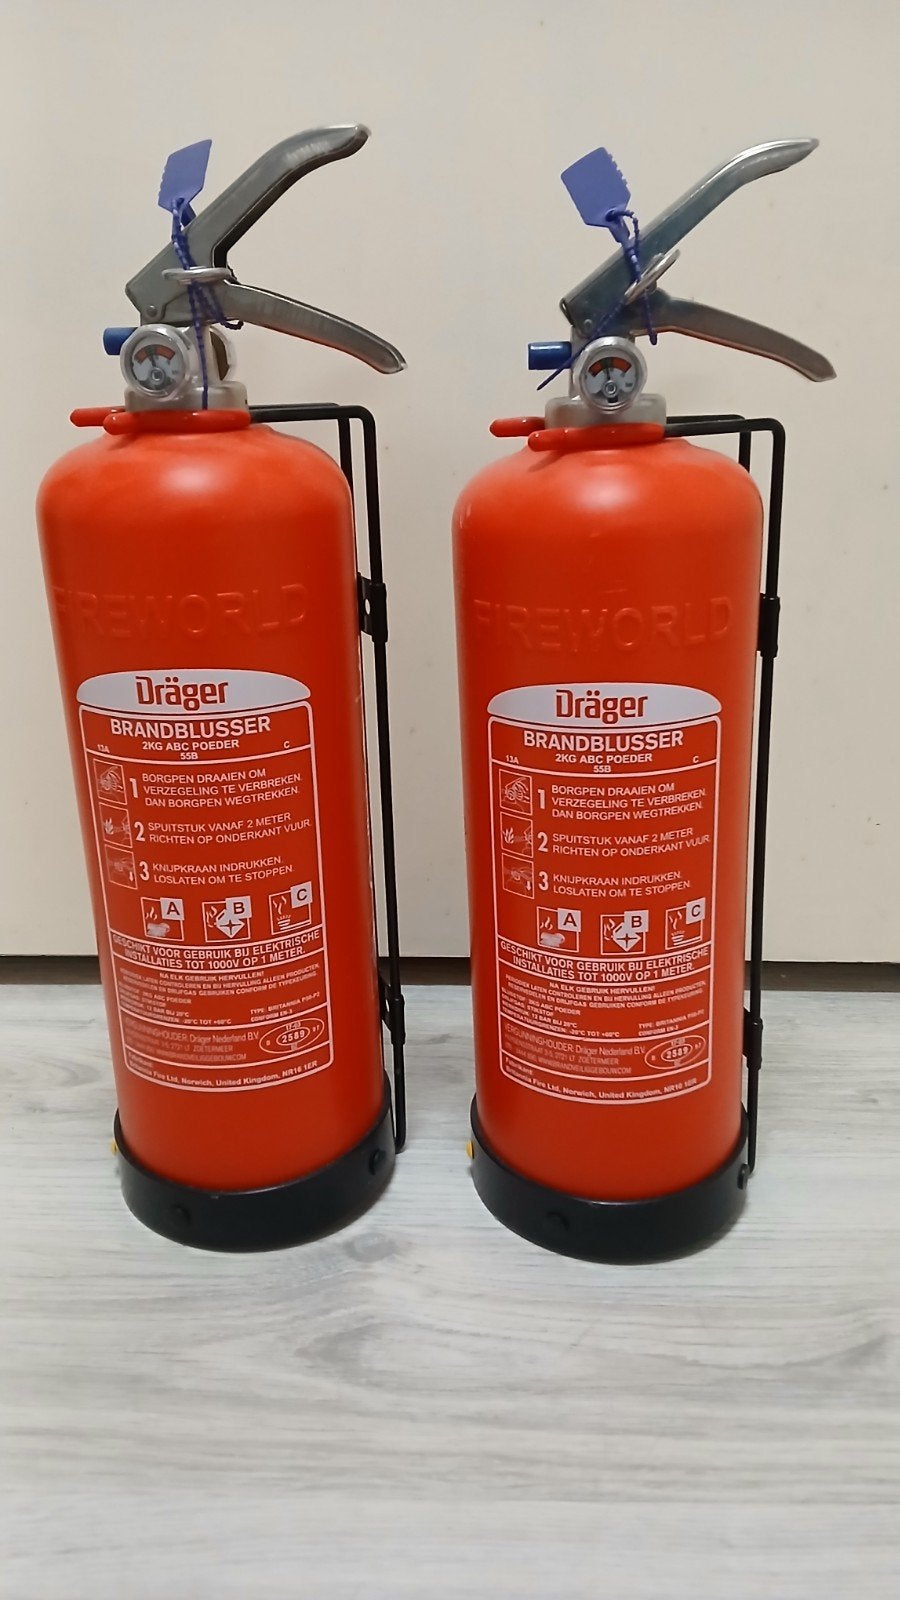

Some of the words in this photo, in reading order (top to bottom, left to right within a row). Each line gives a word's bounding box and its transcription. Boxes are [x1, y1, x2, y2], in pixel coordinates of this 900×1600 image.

[136, 675, 228, 711] Dräger
[556, 689, 648, 724] Dräger
[110, 716, 270, 739] BRANDBLUSSER
[142, 740, 162, 751] 2KG
[166, 741, 189, 751] ABC
[192, 739, 239, 751] POEDER
[523, 730, 683, 752] BRANDBLUSSER
[180, 752, 198, 760] 55B
[505, 755, 519, 764] 13A
[555, 754, 576, 763] 2KG
[579, 754, 603, 764] ABC
[606, 753, 652, 763] POEDER
[142, 773, 194, 784] BORGPEN
[197, 772, 246, 783] DRAAIEN
[249, 768, 266, 778] OM
[130, 779, 138, 797] 1
[144, 785, 219, 796] VERZEGELING
[222, 784, 236, 794] TE
[551, 785, 604, 796] BORGPEN
[607, 785, 655, 796] DRAAIEN
[658, 782, 674, 792] OM
[145, 798, 165, 807] DAN
[168, 797, 222, 808] BORGPEN
[537, 789, 546, 809] 1
[552, 798, 628, 808] VERZEGELING
[631, 797, 645, 807] TE
[552, 809, 573, 819] DAN
[576, 810, 630, 820] BORGPEN
[148, 821, 206, 833] SPUITSTUK
[209, 820, 243, 832] VANAF
[247, 820, 253, 828] 2
[256, 812, 291, 827] METER
[135, 822, 145, 841] 2
[149, 833, 194, 845] RICHTEN
[197, 834, 211, 844] OP
[216, 827, 282, 843] ONDERKANT
[552, 833, 612, 845] SPUITSTUK
[614, 834, 649, 845] VANAF
[652, 834, 658, 842] 2
[660, 828, 693, 841] METER
[538, 832, 548, 852] 2
[552, 846, 599, 857] RICHTEN
[602, 848, 617, 857] OP
[621, 842, 683, 856] ONDERKANT
[140, 862, 149, 880] 3
[153, 863, 217, 874] KNIJPKRAAN
[154, 874, 205, 885] LOSLATEN
[208, 874, 225, 884] OM
[228, 873, 242, 883] TE
[539, 872, 548, 890] 3
[553, 874, 618, 885] KNIJPKRAAN
[297, 889, 308, 900] C
[554, 885, 606, 897] LOSLATEN
[609, 887, 627, 897] OM
[629, 887, 642, 896] TE
[167, 902, 180, 916] A
[233, 902, 244, 914] B
[691, 904, 701, 916] C
[563, 913, 577, 926] A
[632, 916, 642, 927] B
[113, 935, 151, 954] GESCHIKT
[154, 948, 181, 959] VOOR
[184, 949, 231, 959] GEBRUIK
[253, 930, 320, 956] ELEKTRISCHE
[125, 948, 182, 968] INSTALLATIES
[184, 960, 204, 969] TOT
[208, 959, 240, 970] 1000V
[243, 956, 258, 966] OP
[261, 955, 266, 964] 1
[269, 946, 306, 964] METER.
[500, 942, 542, 963] GESCHIKT
[544, 957, 573, 969] VOOR
[576, 962, 624, 972] GEBRUIK
[646, 947, 708, 969] ELEKTRISCHE
[513, 957, 574, 980] INSTALLATIES
[578, 972, 597, 981] TOT
[602, 972, 632, 982] 1000V
[635, 970, 651, 980] OP
[654, 969, 658, 978] 1
[662, 963, 694, 977] METER.
[184, 974, 217, 982] GEBRUIK
[262, 972, 286, 984] ALLEEN
[236, 984, 267, 994] CONFORM
[281, 1030, 305, 1043] 2589
[666, 1047, 688, 1059] 2589
[216, 1078, 241, 1086] United
[304, 1060, 318, 1071] 1ER
[599, 1091, 624, 1099] United
